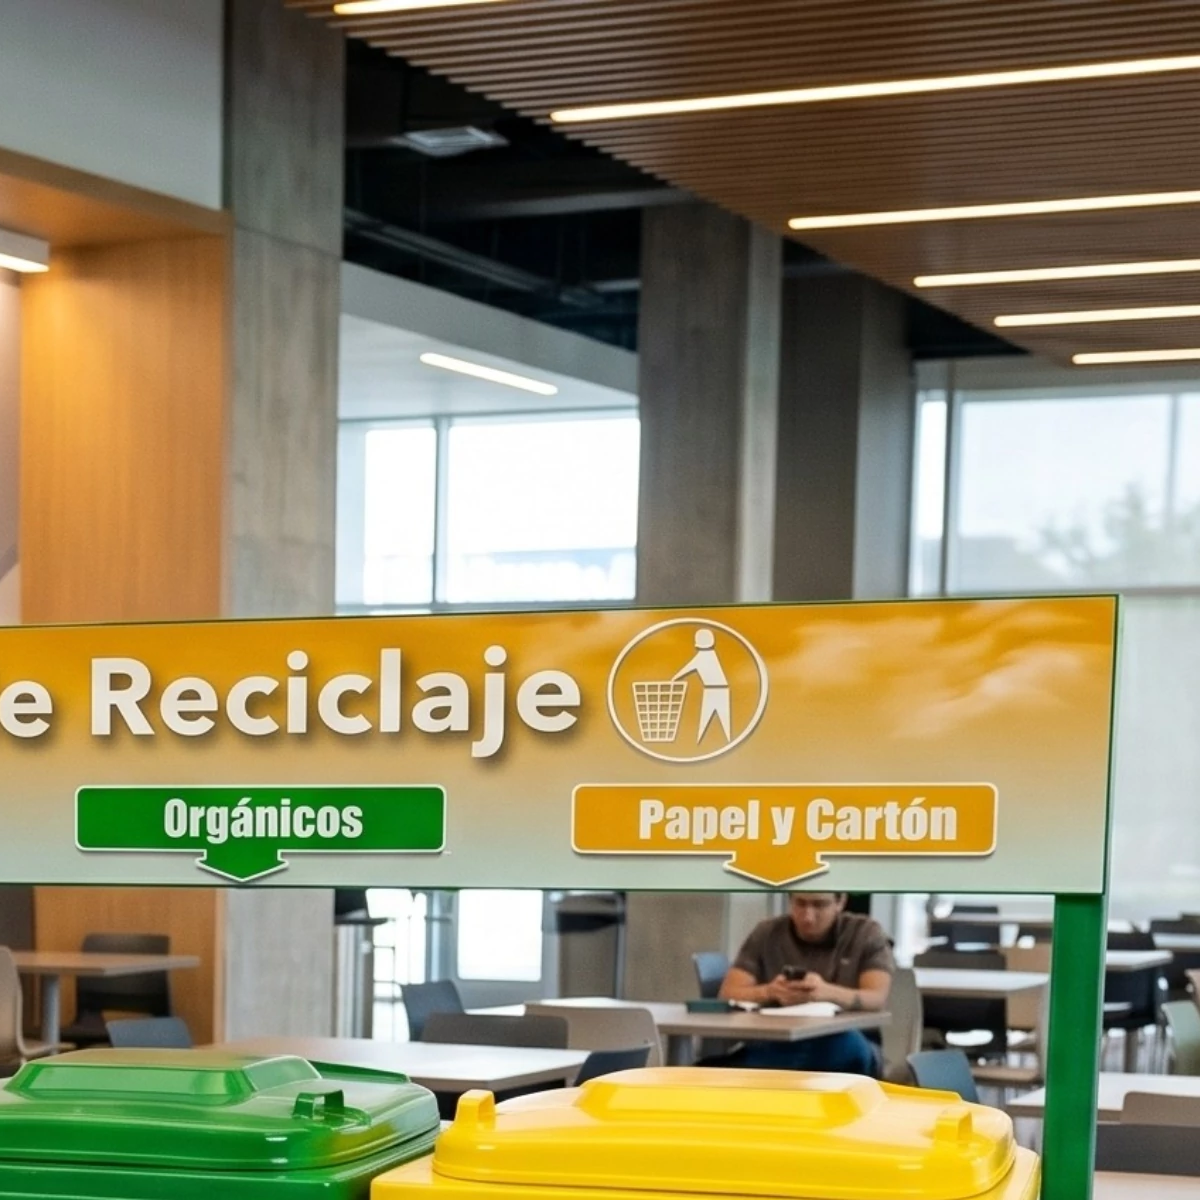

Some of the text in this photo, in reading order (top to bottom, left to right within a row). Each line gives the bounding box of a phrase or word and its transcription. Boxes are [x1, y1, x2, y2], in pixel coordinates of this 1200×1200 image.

[91, 645, 581, 757] Reciclaje
[164, 797, 363, 844] Orgánicos
[639, 797, 957, 845] Papel y Cartón
